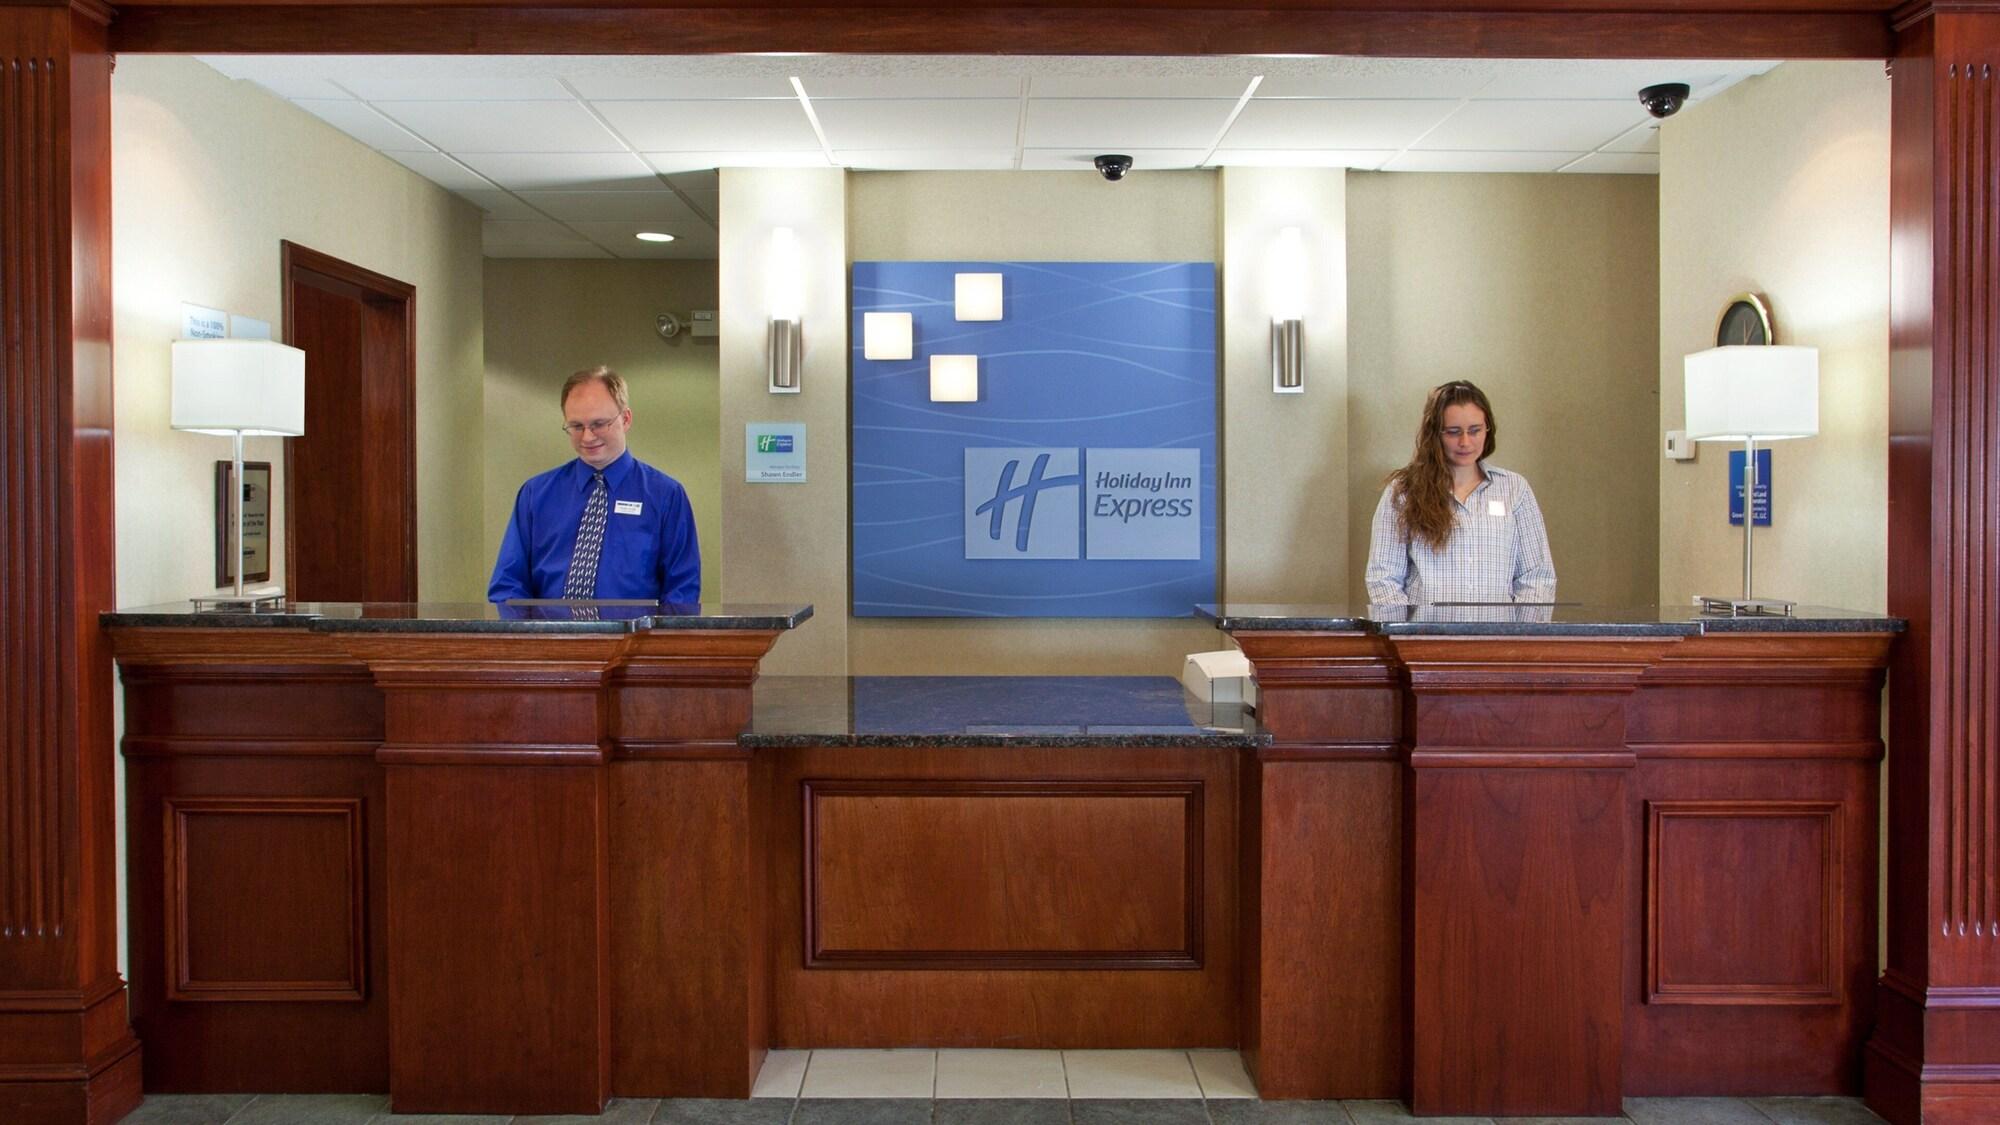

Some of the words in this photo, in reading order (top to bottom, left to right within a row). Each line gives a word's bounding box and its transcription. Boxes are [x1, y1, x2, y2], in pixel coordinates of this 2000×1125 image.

[1096, 472, 1162, 492] Holiday
[1165, 472, 1192, 489] Inn
[1094, 494, 1193, 524] Express
